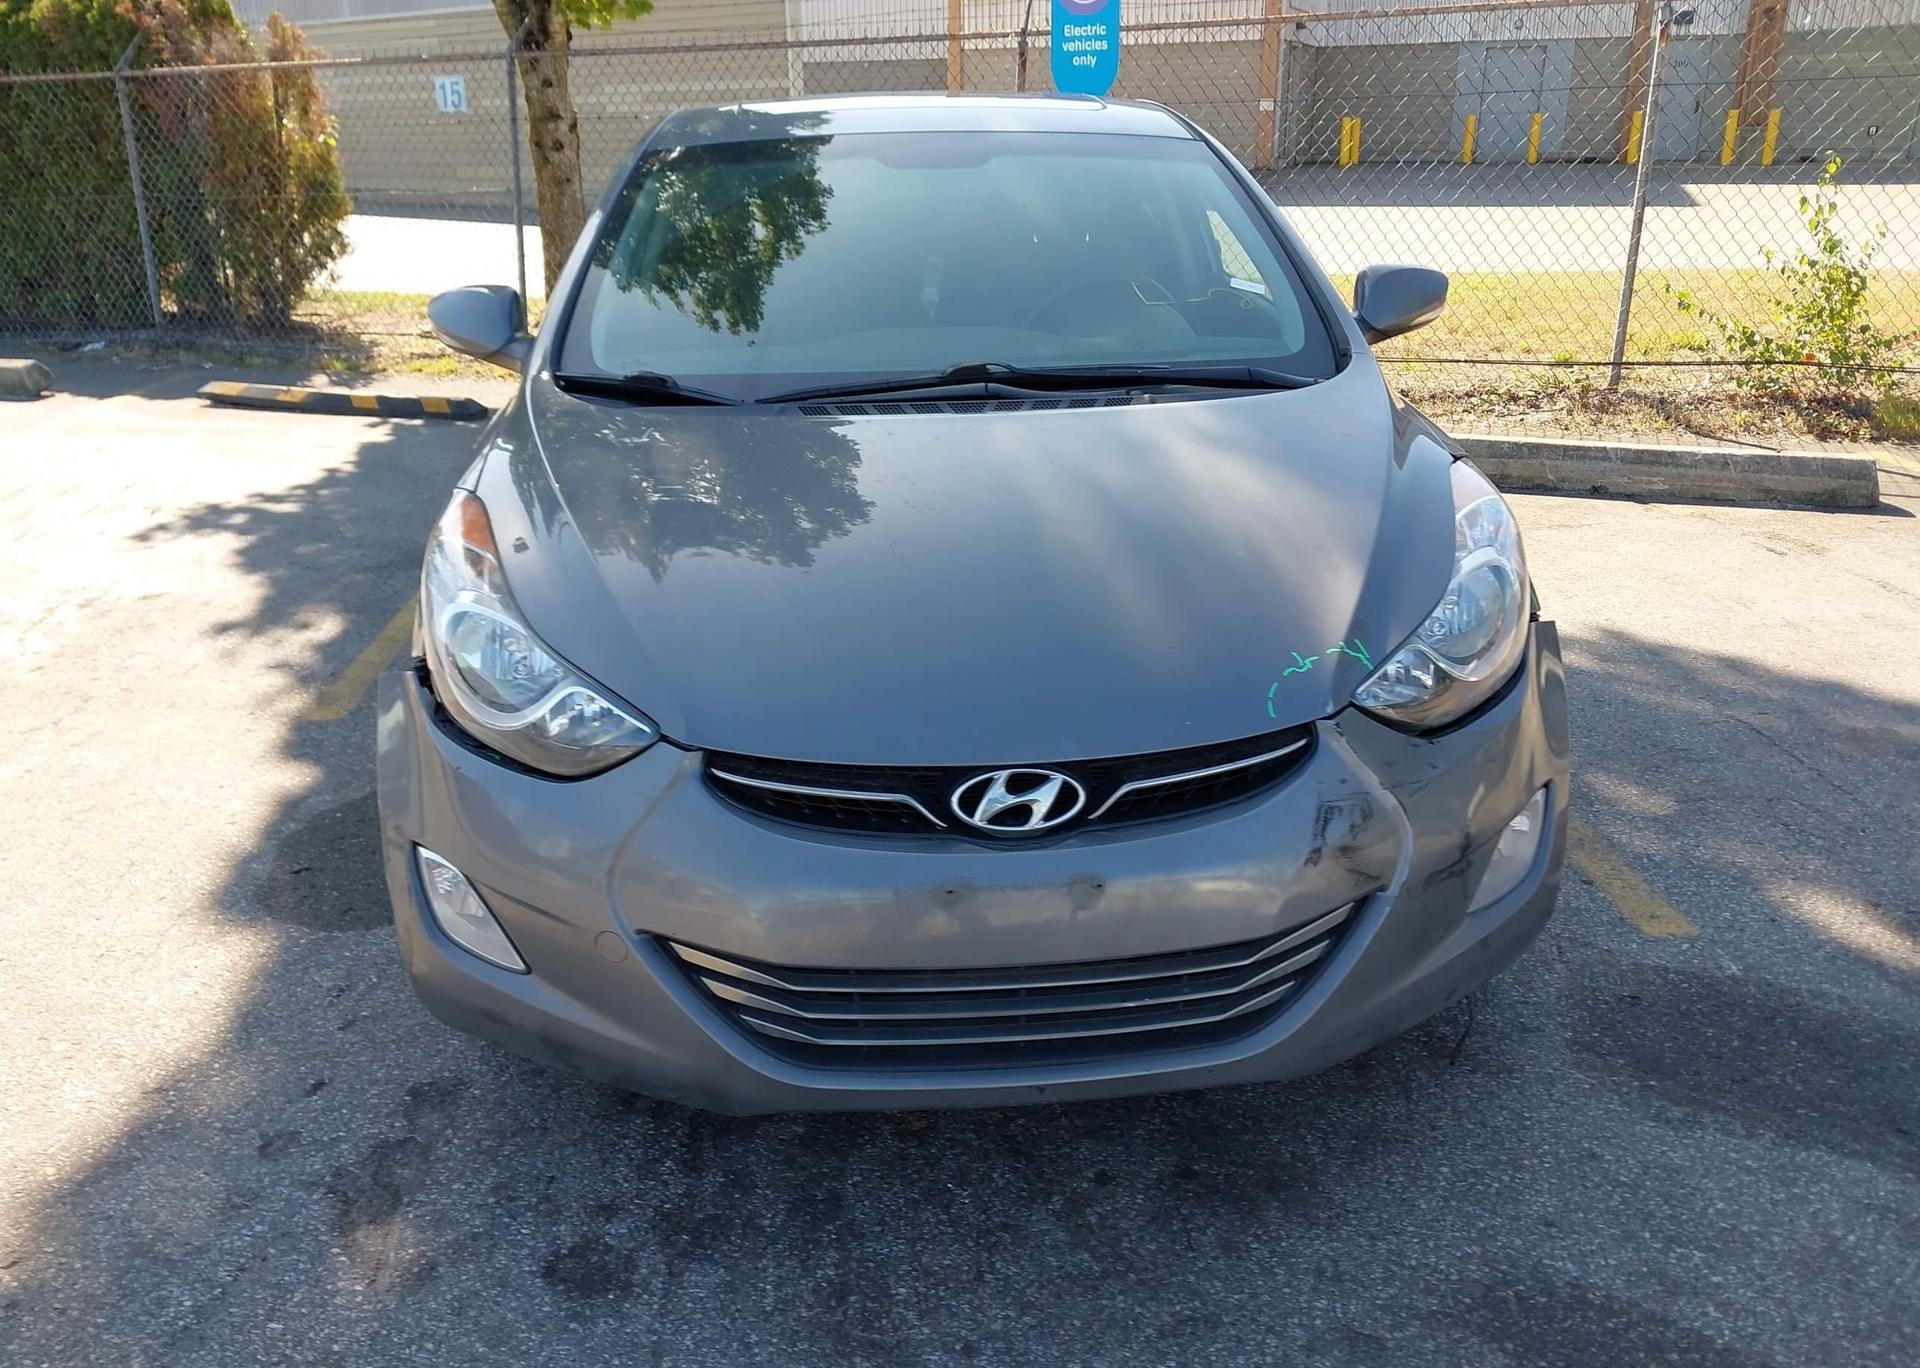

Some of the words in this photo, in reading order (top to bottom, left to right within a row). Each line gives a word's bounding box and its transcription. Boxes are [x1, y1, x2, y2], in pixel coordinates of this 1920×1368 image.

[1064, 24, 1107, 37] Electric
[1062, 39, 1108, 52] vehicles
[1072, 54, 1097, 68] only
[438, 79, 462, 109] 15
